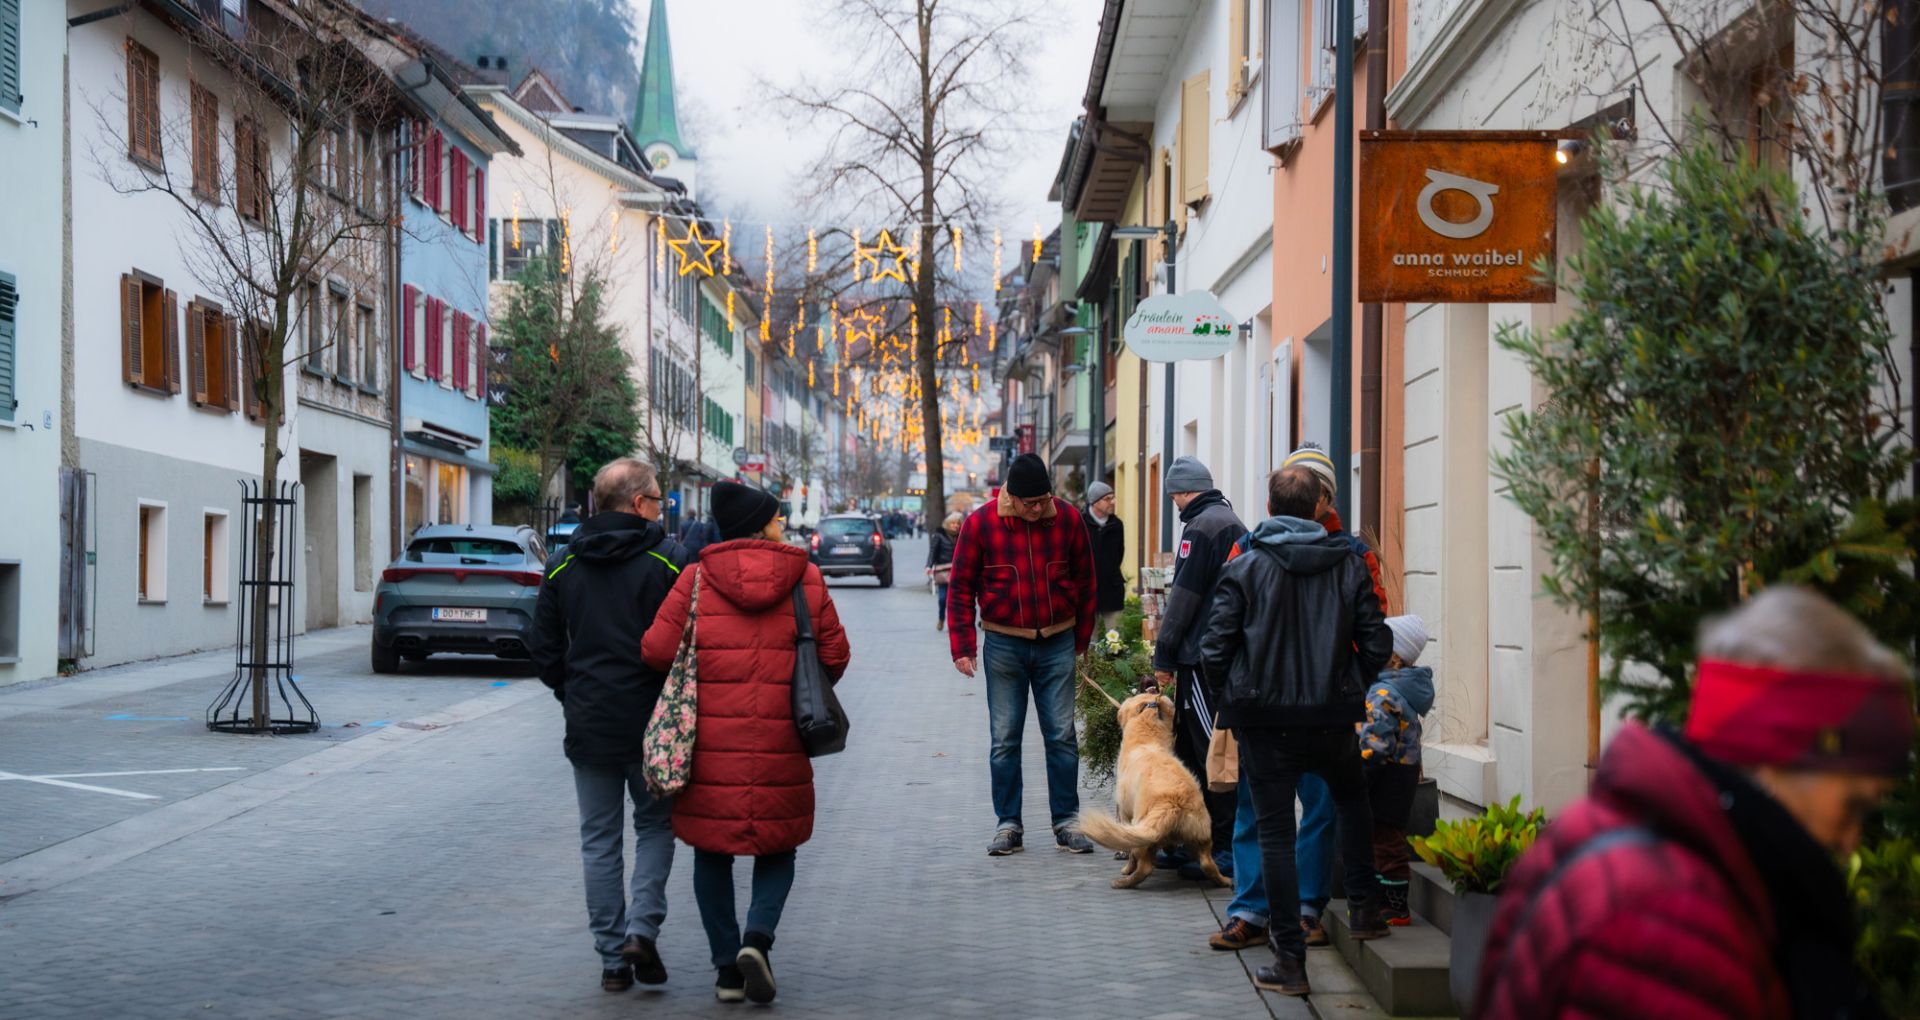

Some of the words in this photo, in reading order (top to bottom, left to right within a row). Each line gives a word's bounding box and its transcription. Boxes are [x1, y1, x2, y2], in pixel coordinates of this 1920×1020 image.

[1392, 252, 1444, 266] anna
[1452, 248, 1523, 266] waibel
[1428, 268, 1488, 277] SCHMUCK
[1130, 309, 1183, 328] fräulein
[1146, 325, 1185, 335] amann
